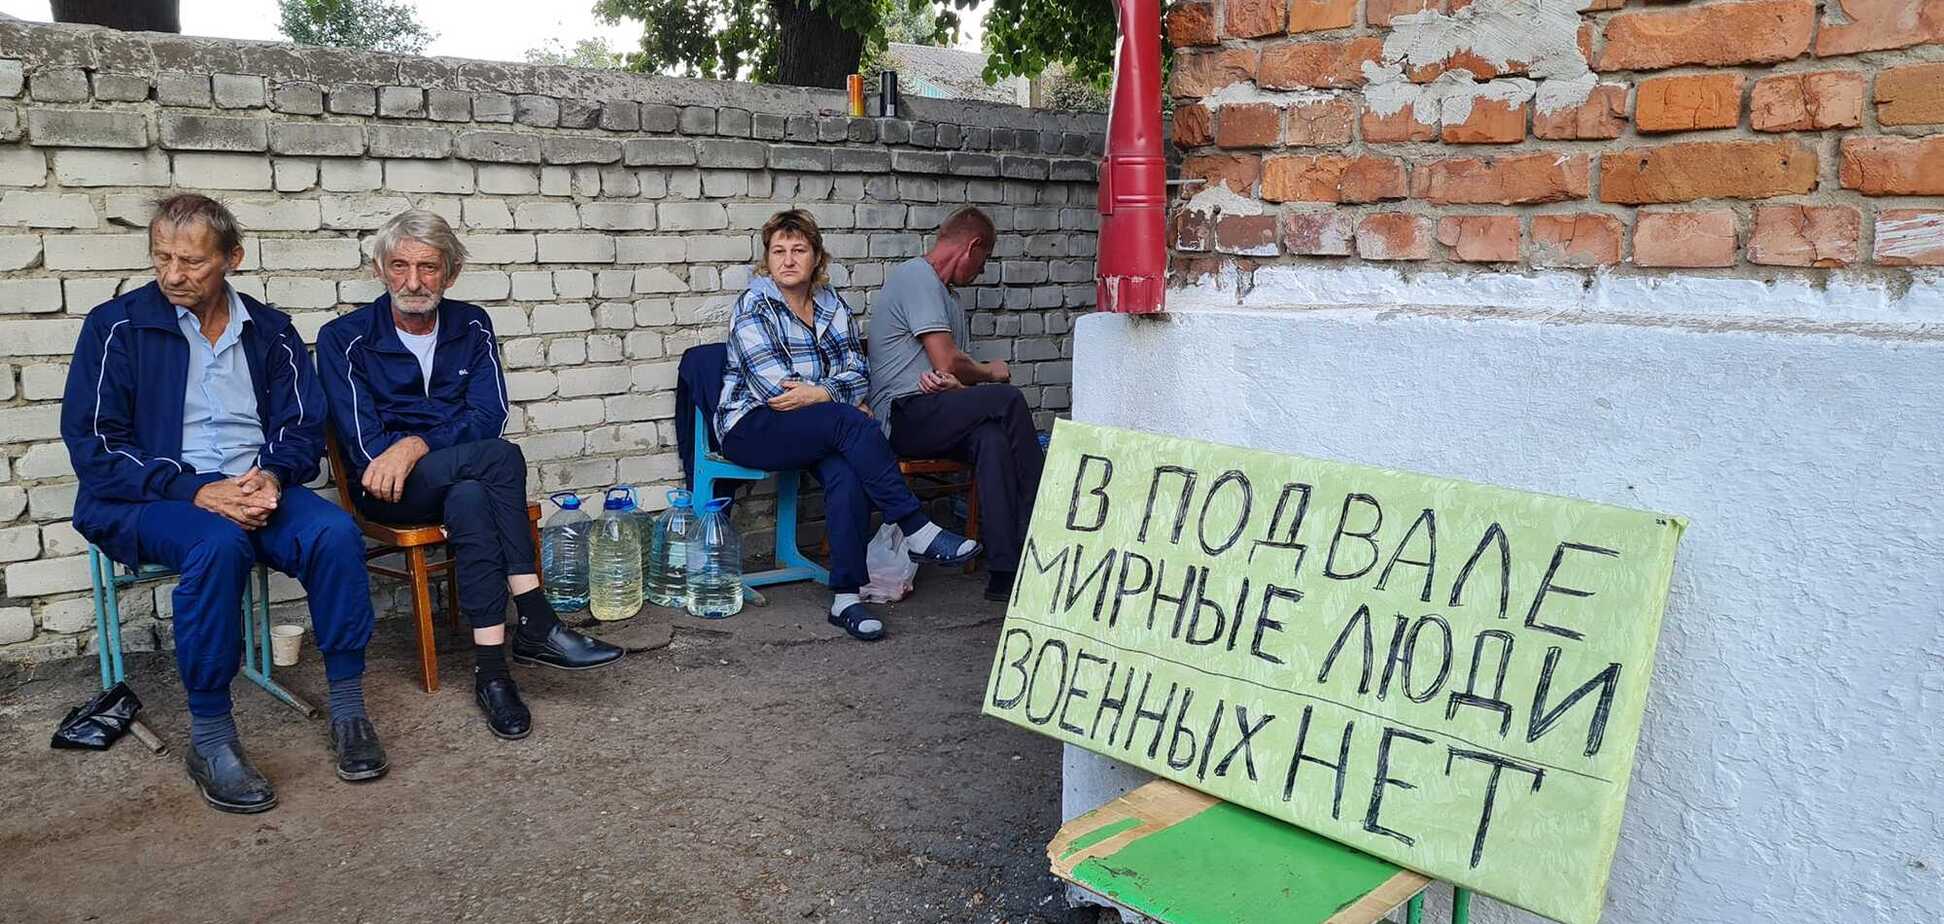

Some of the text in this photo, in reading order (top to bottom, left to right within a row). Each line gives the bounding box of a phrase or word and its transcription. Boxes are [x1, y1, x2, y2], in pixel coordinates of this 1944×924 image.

[1014, 536, 1622, 757] МИРНЫЕ ЛЮДИ
[1066, 454, 1620, 641] В ПОДВАЛЕ
[993, 628, 1546, 869] ВОЕННЫХ НЕТ
